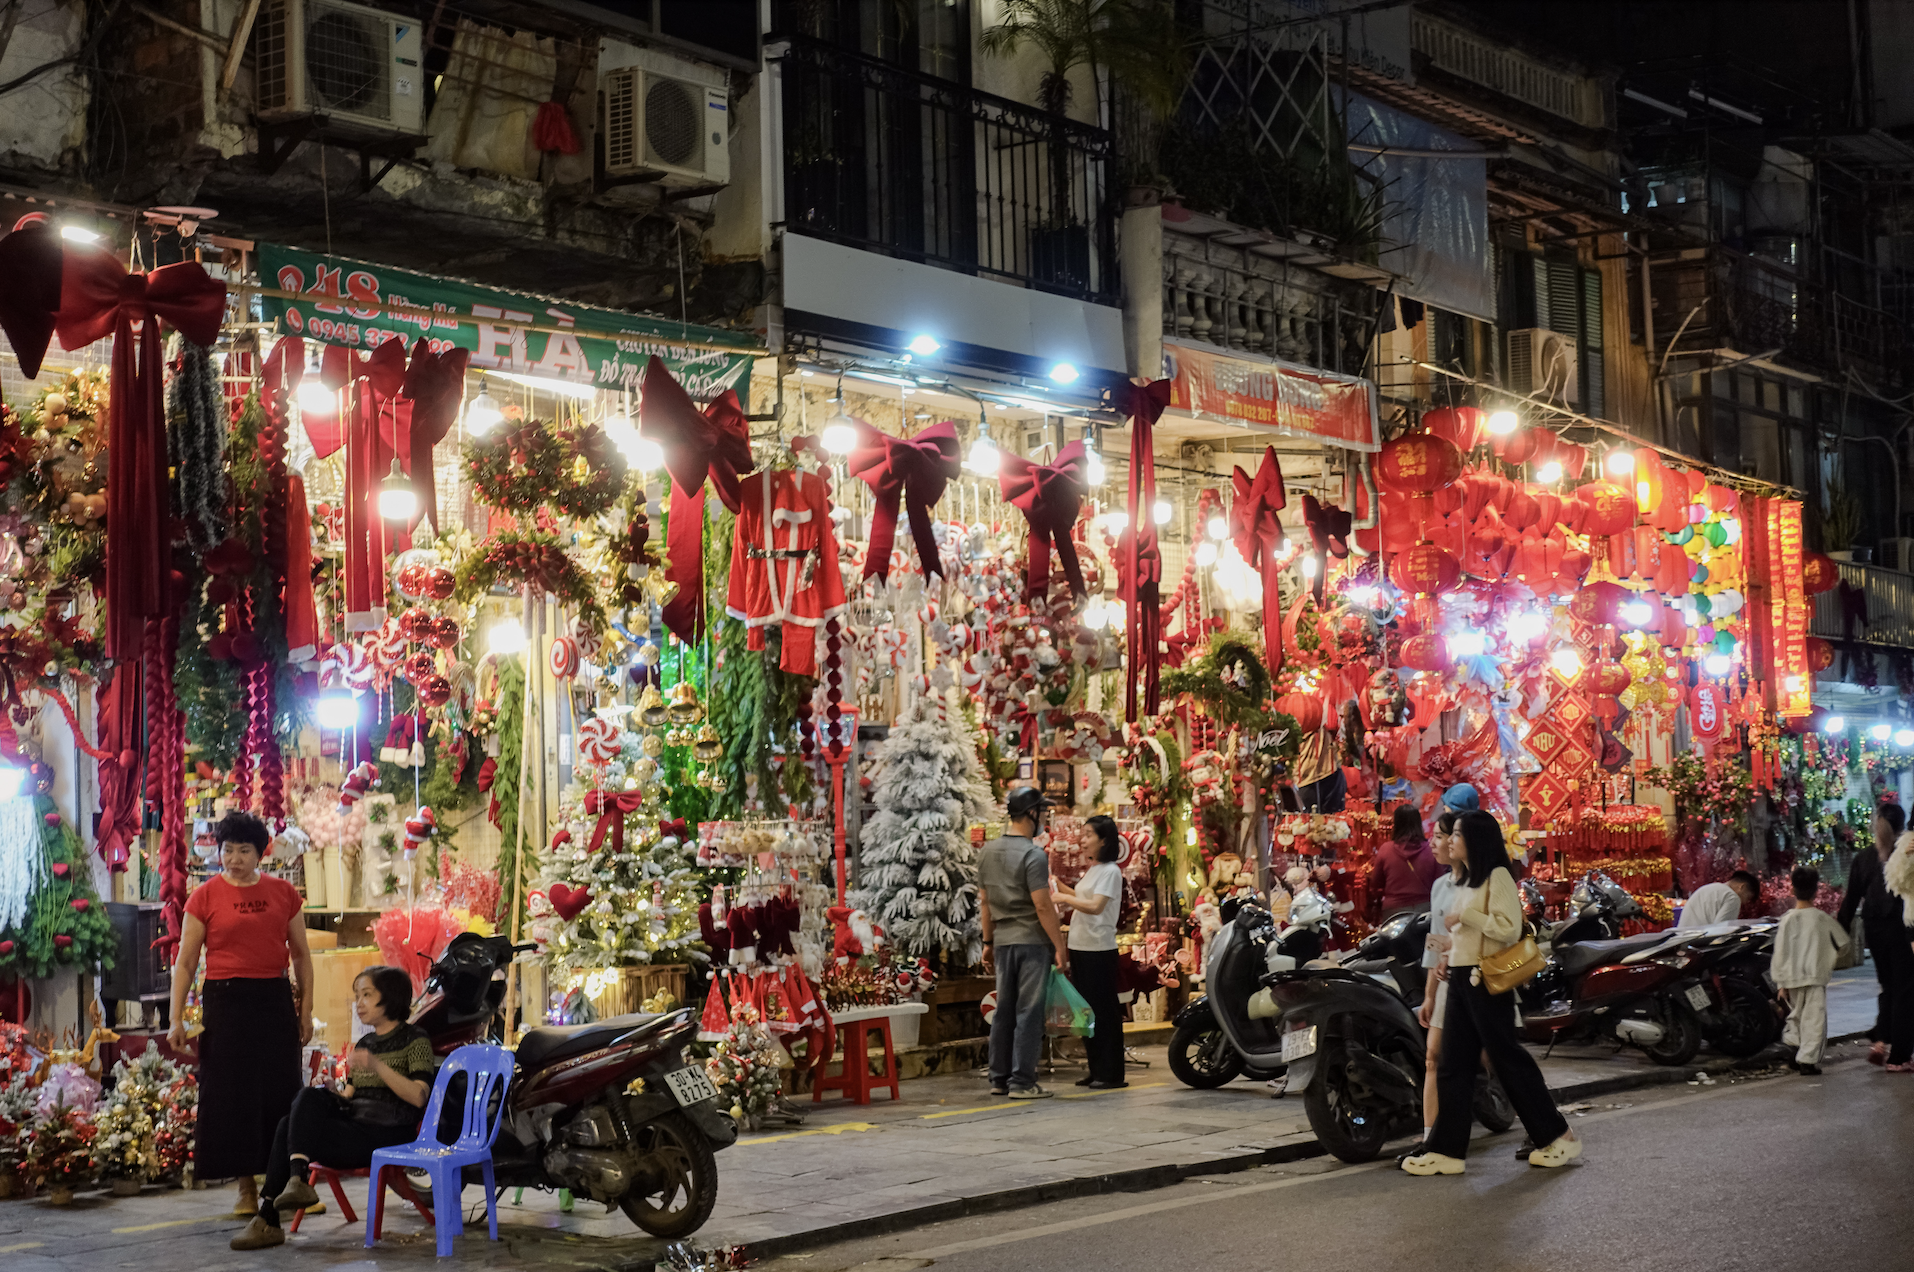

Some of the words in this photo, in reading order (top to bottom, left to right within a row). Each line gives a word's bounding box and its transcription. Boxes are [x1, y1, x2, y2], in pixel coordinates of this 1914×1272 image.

[305, 263, 382, 319] 48
[308, 317, 361, 345] 0945
[468, 304, 596, 384] HÀ
[233, 900, 270, 911] PRADA
[680, 1081, 712, 1103] 8275
